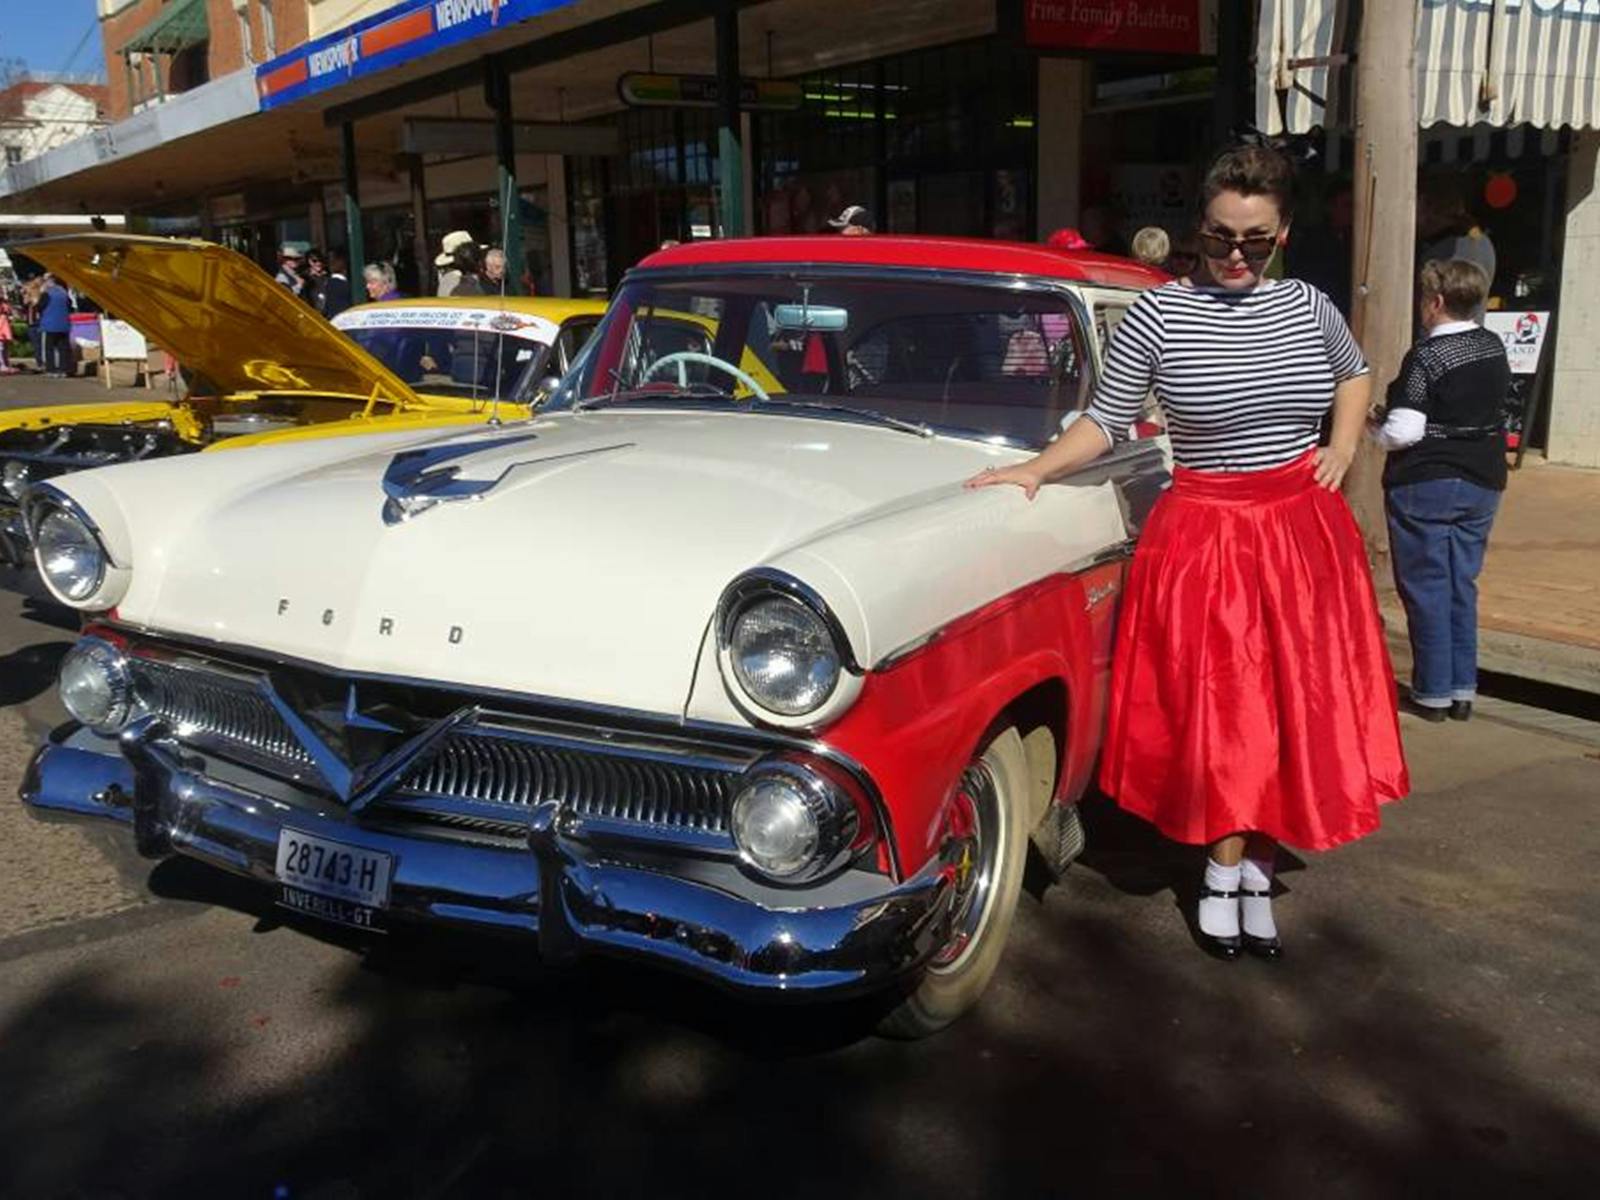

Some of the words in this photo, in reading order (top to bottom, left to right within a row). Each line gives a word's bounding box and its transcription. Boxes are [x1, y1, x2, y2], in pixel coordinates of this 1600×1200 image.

[1071, 1, 1122, 34] Family
[1127, 1, 1190, 30] Butchers
[278, 598, 463, 645] FORD
